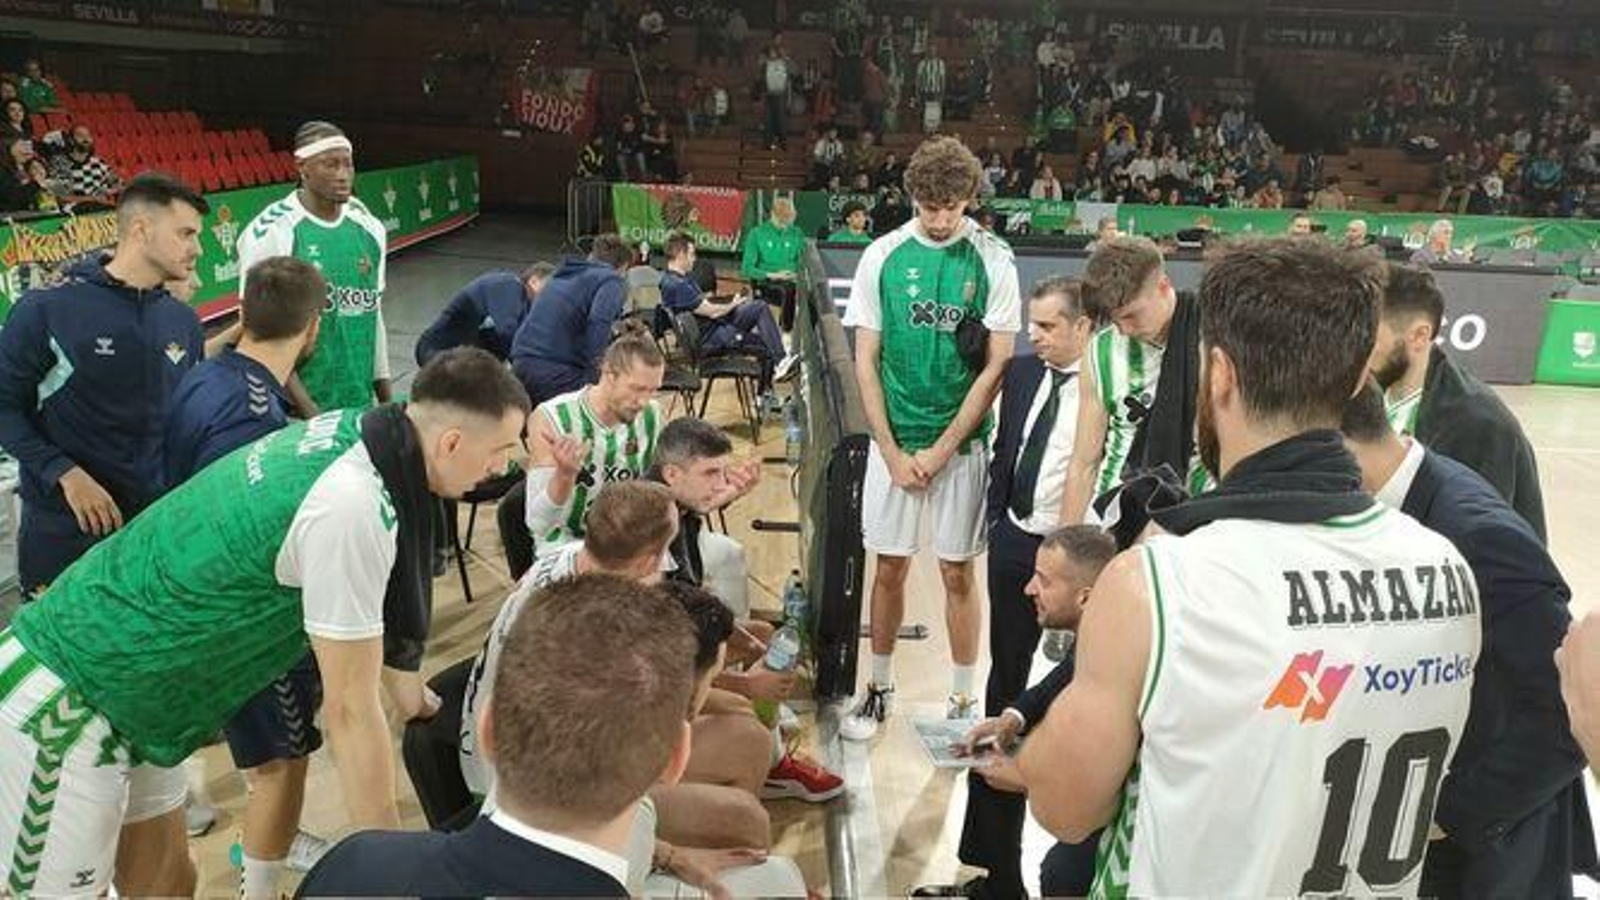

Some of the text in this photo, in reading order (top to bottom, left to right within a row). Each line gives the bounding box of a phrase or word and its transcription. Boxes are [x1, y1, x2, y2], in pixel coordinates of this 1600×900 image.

[73, 4, 139, 24] SEVILLA
[522, 88, 584, 119] FONDO
[522, 106, 575, 134] SIOUX
[1298, 727, 1451, 897] 10
